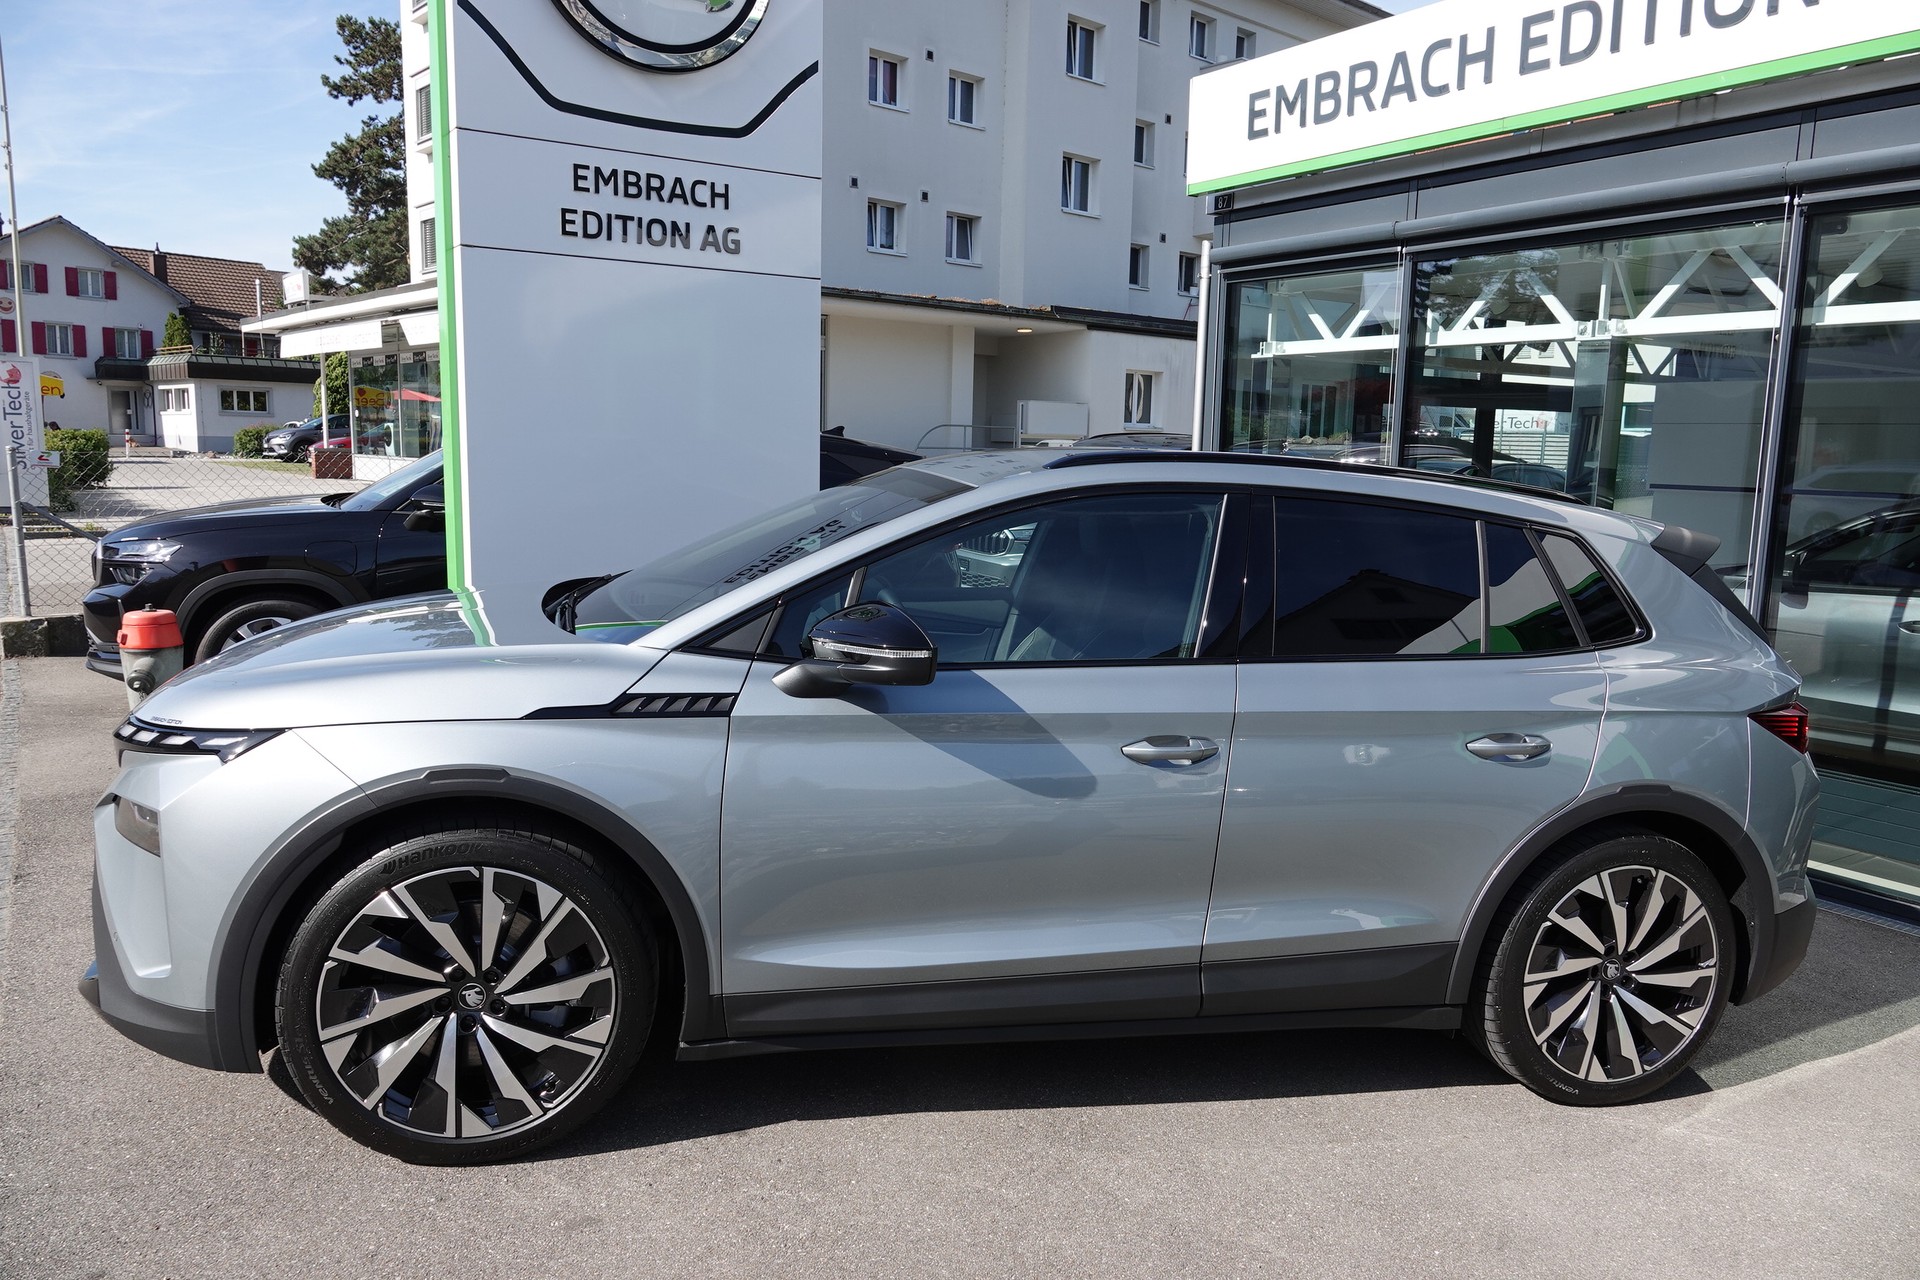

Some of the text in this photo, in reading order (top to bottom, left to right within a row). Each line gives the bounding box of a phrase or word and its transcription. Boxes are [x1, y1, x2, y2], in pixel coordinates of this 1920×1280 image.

[1247, 26, 1494, 141] EMBRACH
[572, 163, 730, 210] EMBRACH
[1218, 196, 1228, 209] 87
[560, 207, 741, 254] EDITION AG
